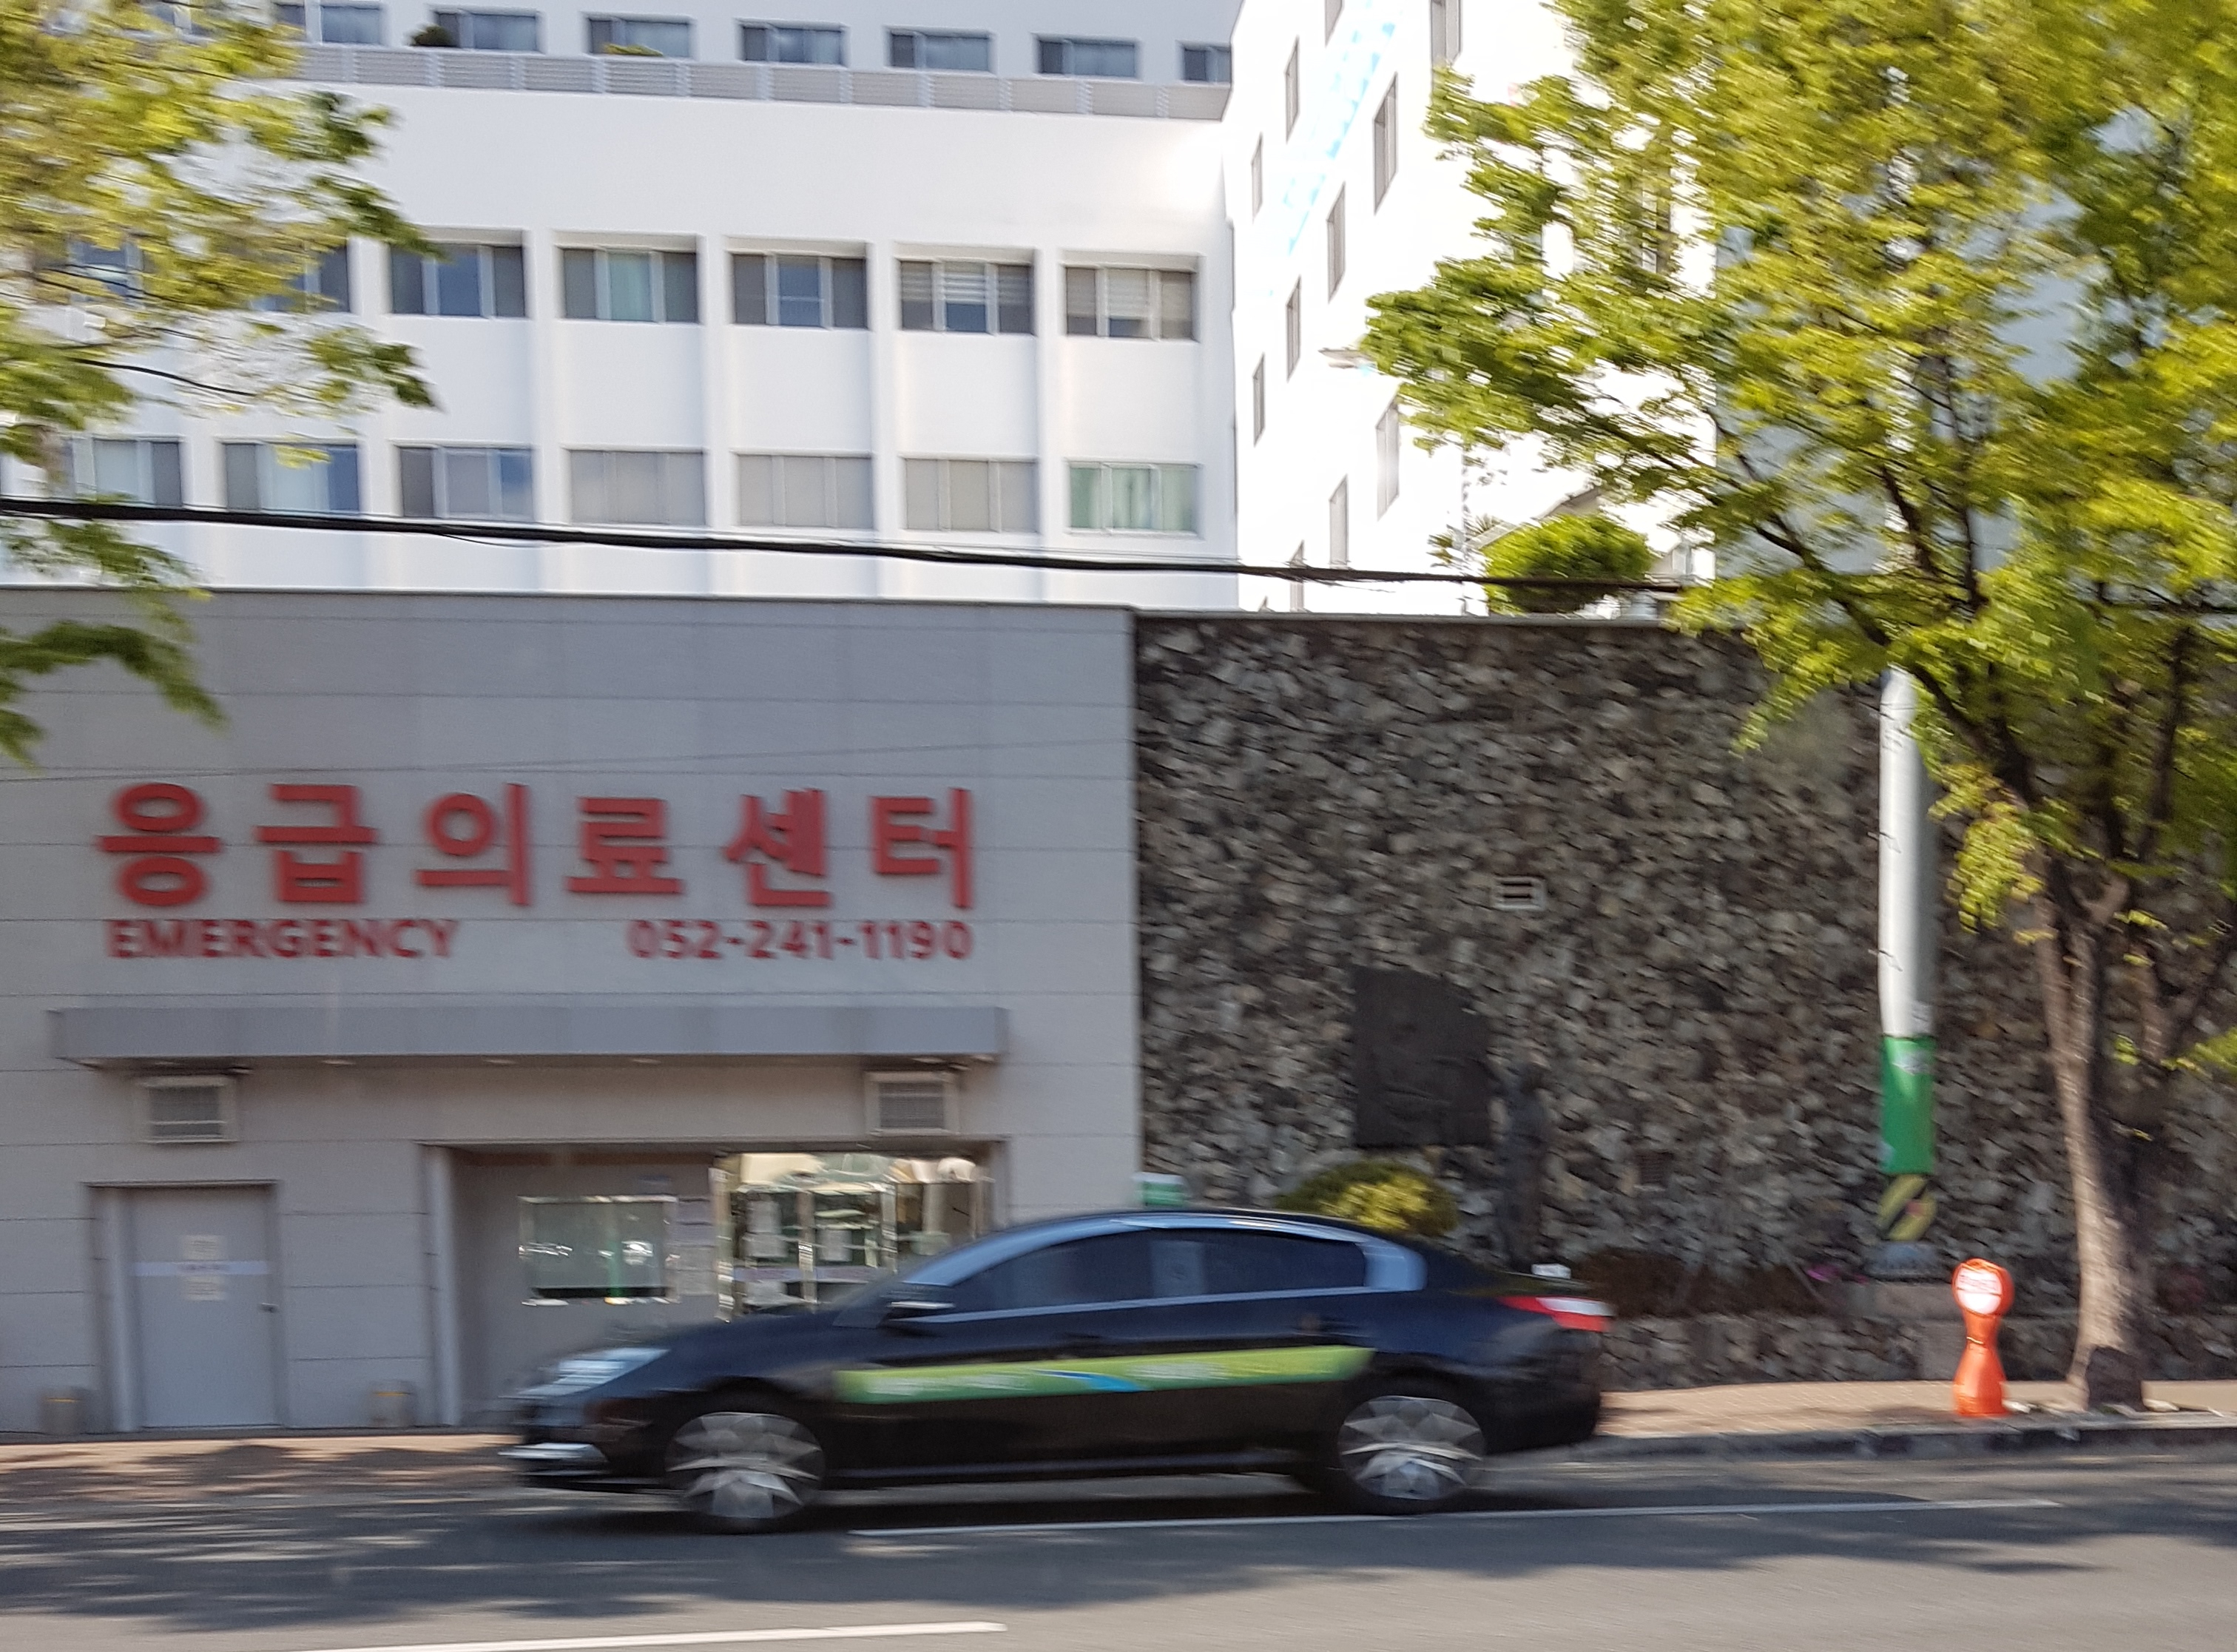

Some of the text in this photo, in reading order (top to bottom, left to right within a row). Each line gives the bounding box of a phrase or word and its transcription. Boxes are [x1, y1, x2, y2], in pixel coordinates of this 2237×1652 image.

[98, 781, 974, 910] 응급의료센터
[107, 919, 458, 959] EMERGENCY
[627, 920, 974, 960] 052-241-1190
